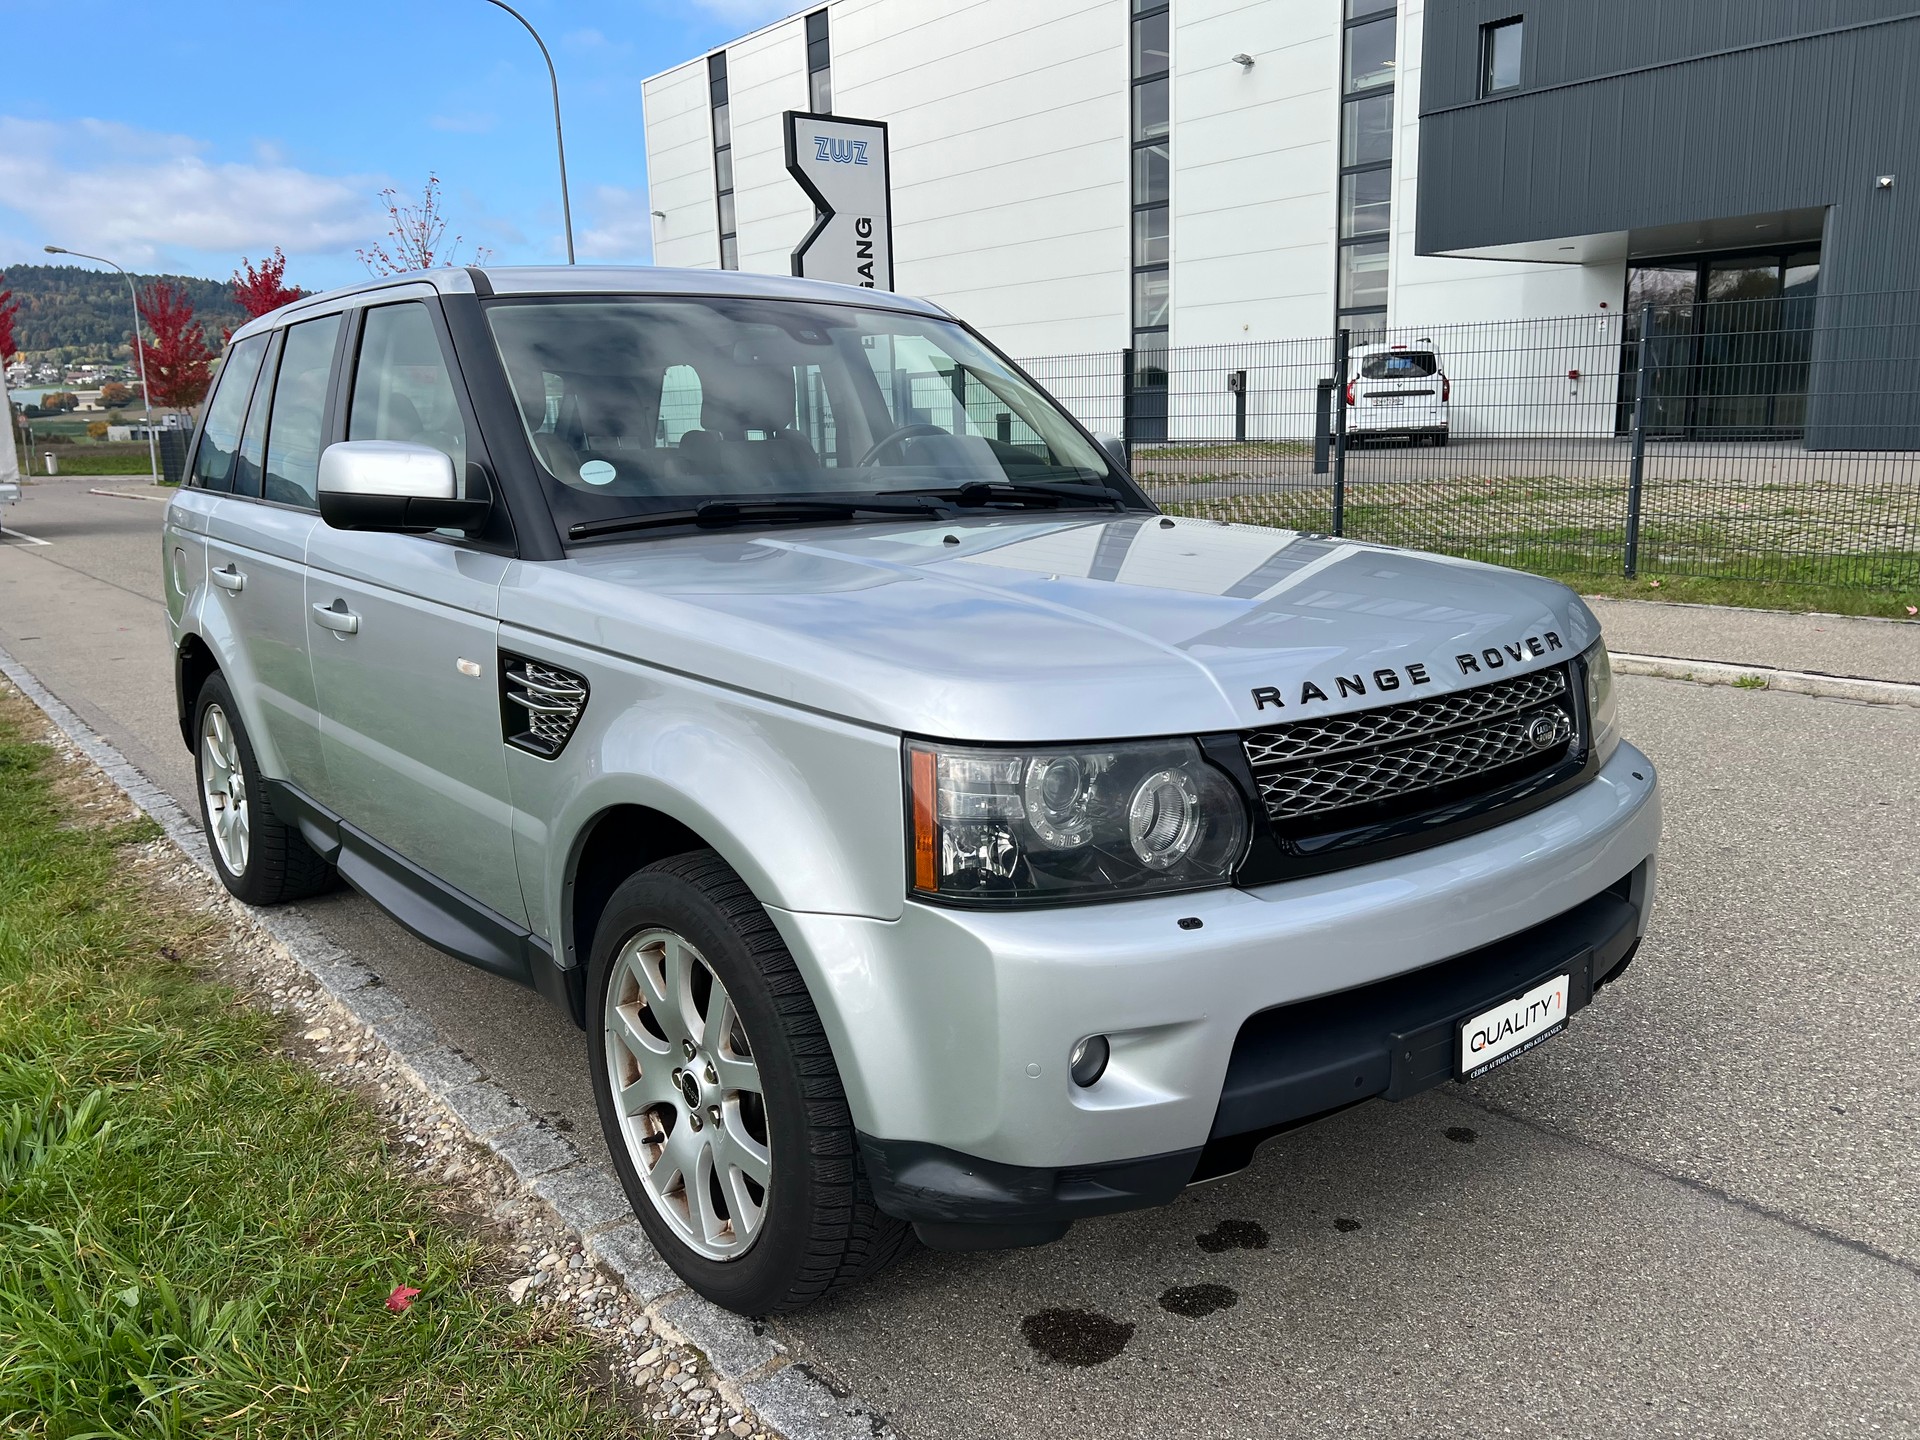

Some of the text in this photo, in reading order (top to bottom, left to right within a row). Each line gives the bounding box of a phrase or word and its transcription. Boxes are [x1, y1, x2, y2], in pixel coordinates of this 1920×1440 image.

[814, 136, 868, 166] ZWZ
[1251, 631, 1564, 711] RANGE ROVER
